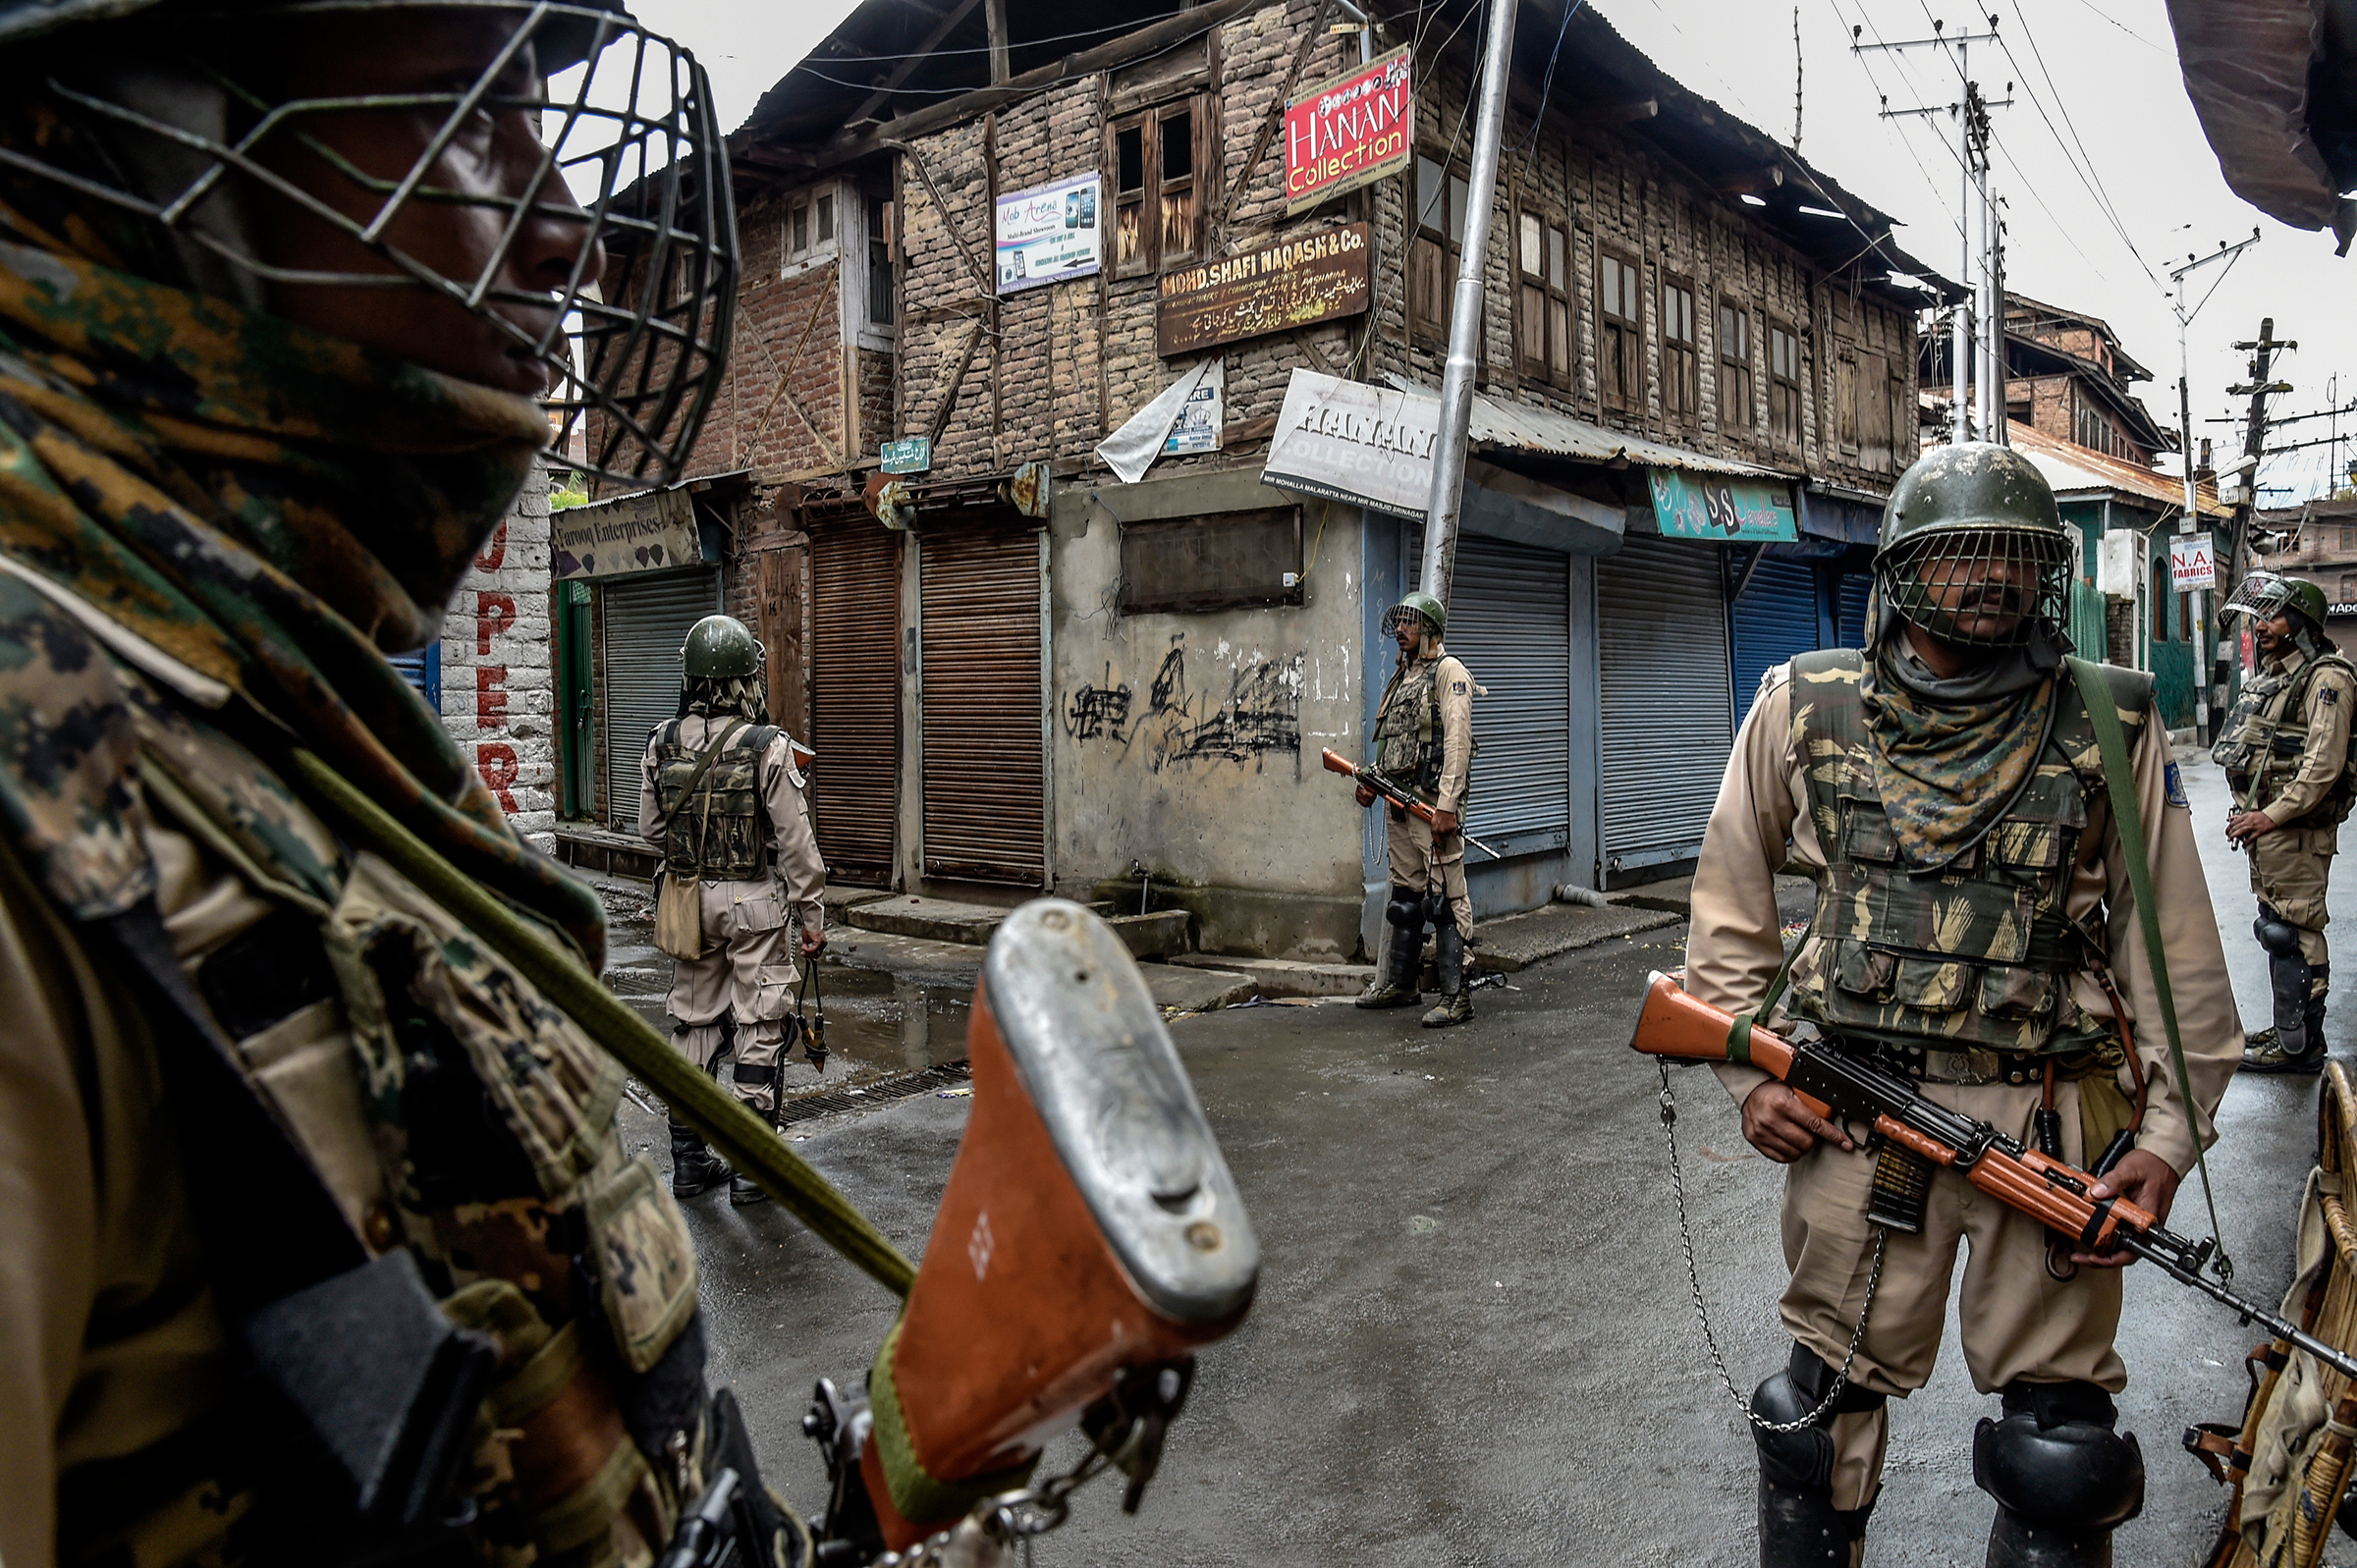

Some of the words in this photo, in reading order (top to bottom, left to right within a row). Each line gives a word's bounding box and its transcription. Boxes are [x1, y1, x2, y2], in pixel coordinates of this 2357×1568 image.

[1290, 87, 1399, 168] HANAN
[1288, 132, 1401, 191] Collection
[1002, 205, 1019, 225] Mob
[1024, 199, 1058, 224] Arena
[1033, 224, 1056, 236] Showroom
[1261, 236, 1327, 272] NAQASH
[1329, 233, 1340, 256] &
[1341, 229, 1365, 252] Co.
[1228, 278, 1269, 295] COMMISSION
[1301, 269, 1346, 288] PASHMINA
[1296, 400, 1438, 460] HANAN
[1264, 474, 1275, 483] MIR
[1276, 477, 1304, 490] MOHALLA
[1304, 484, 1340, 500] MALARATTA
[1340, 493, 1357, 503] NEAR
[1357, 497, 1369, 506] MIR
[1369, 500, 1392, 512] MASJID
[1392, 506, 1425, 519] SRINAGAR
[557, 526, 596, 548] Farooq
[594, 513, 661, 544] Enterprises
[2171, 551, 2213, 568] N.A.
[2173, 566, 2213, 579] FABRICS
